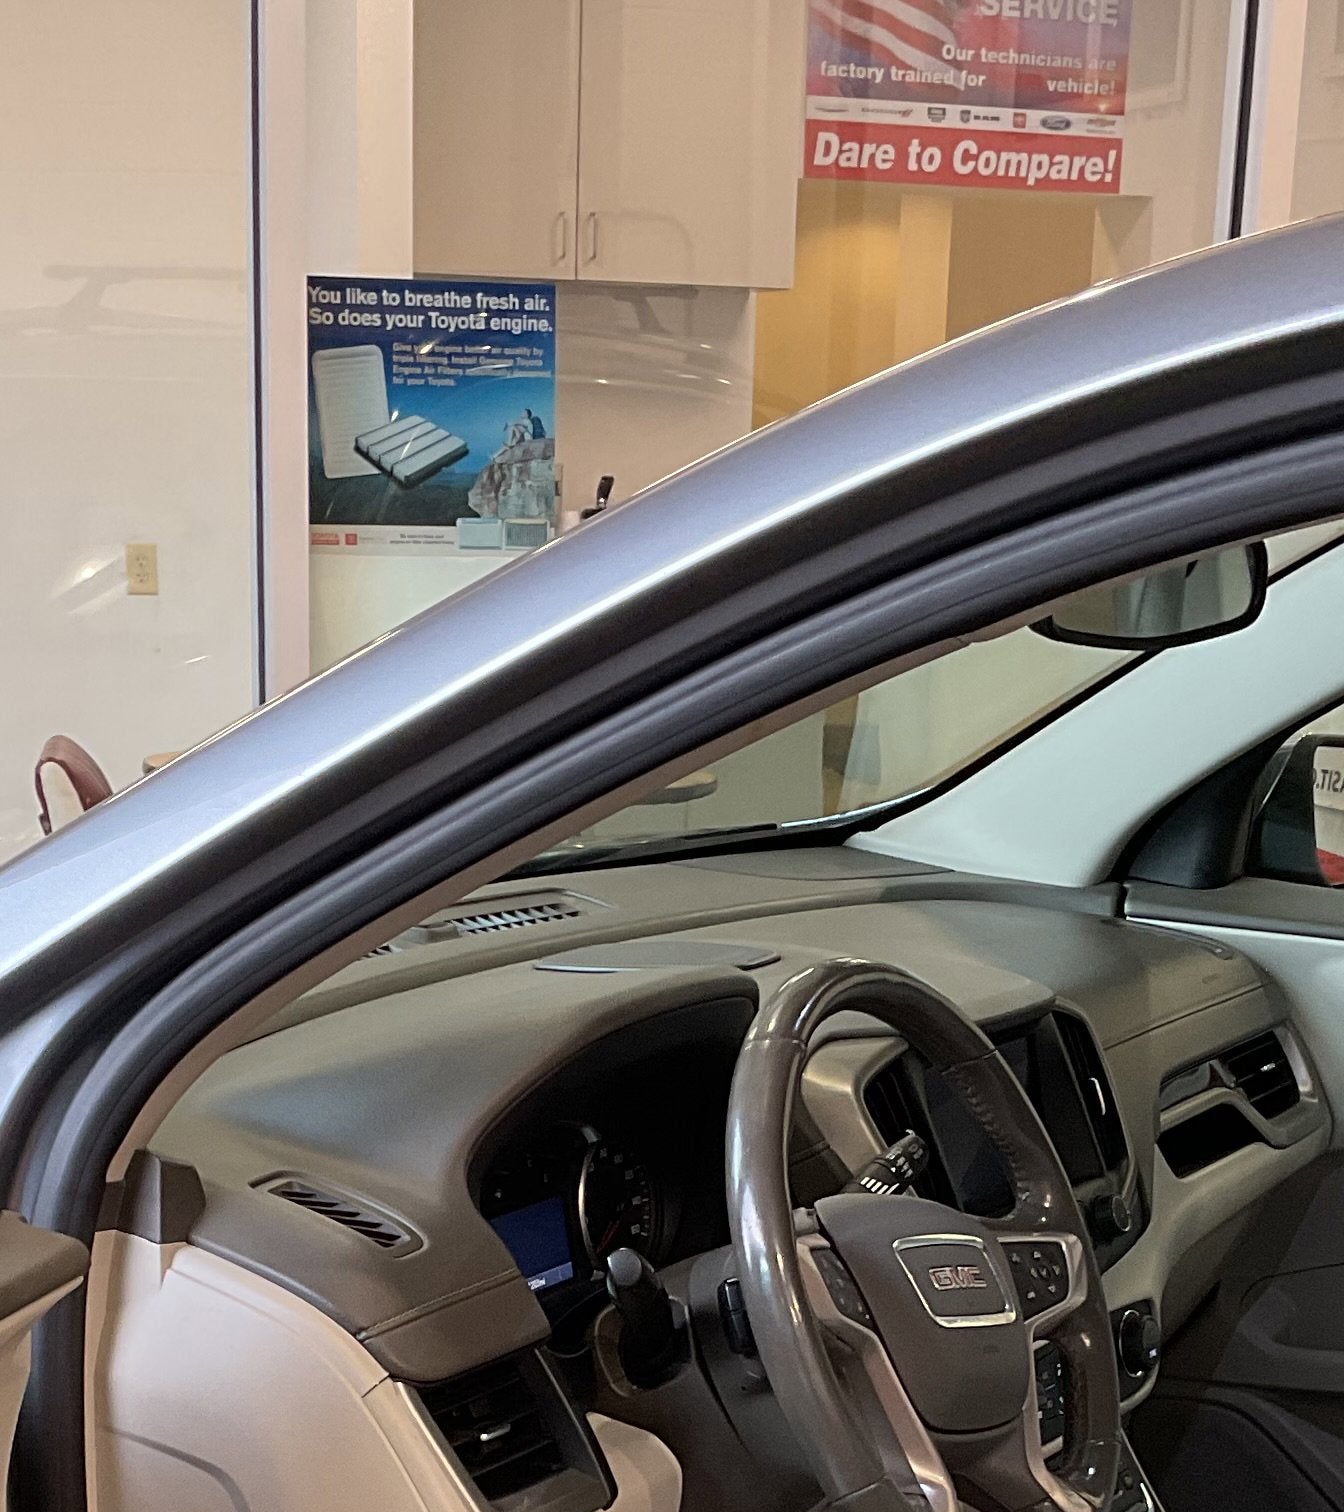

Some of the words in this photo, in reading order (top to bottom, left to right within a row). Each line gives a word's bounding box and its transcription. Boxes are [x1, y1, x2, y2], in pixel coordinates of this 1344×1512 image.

[942, 44, 974, 61] Our
[980, 48, 1083, 69] technicians
[1088, 58, 1116, 71] are
[820, 61, 884, 83] factory
[891, 65, 954, 85] trained
[959, 70, 987, 91] for
[1047, 79, 1116, 96] vehicle!
[813, 131, 896, 170] Dare
[907, 138, 942, 173] to
[953, 139, 1118, 187] Compare!
[308, 286, 341, 305] You
[346, 288, 378, 305] like
[382, 290, 401, 306] to
[405, 290, 472, 309] breathe
[476, 293, 520, 311] fresh
[524, 295, 551, 312] air.
[308, 307, 334, 325] So
[338, 309, 382, 326] does
[386, 313, 425, 331] your
[428, 312, 487, 333] Toyota
[490, 315, 554, 335] engine.
